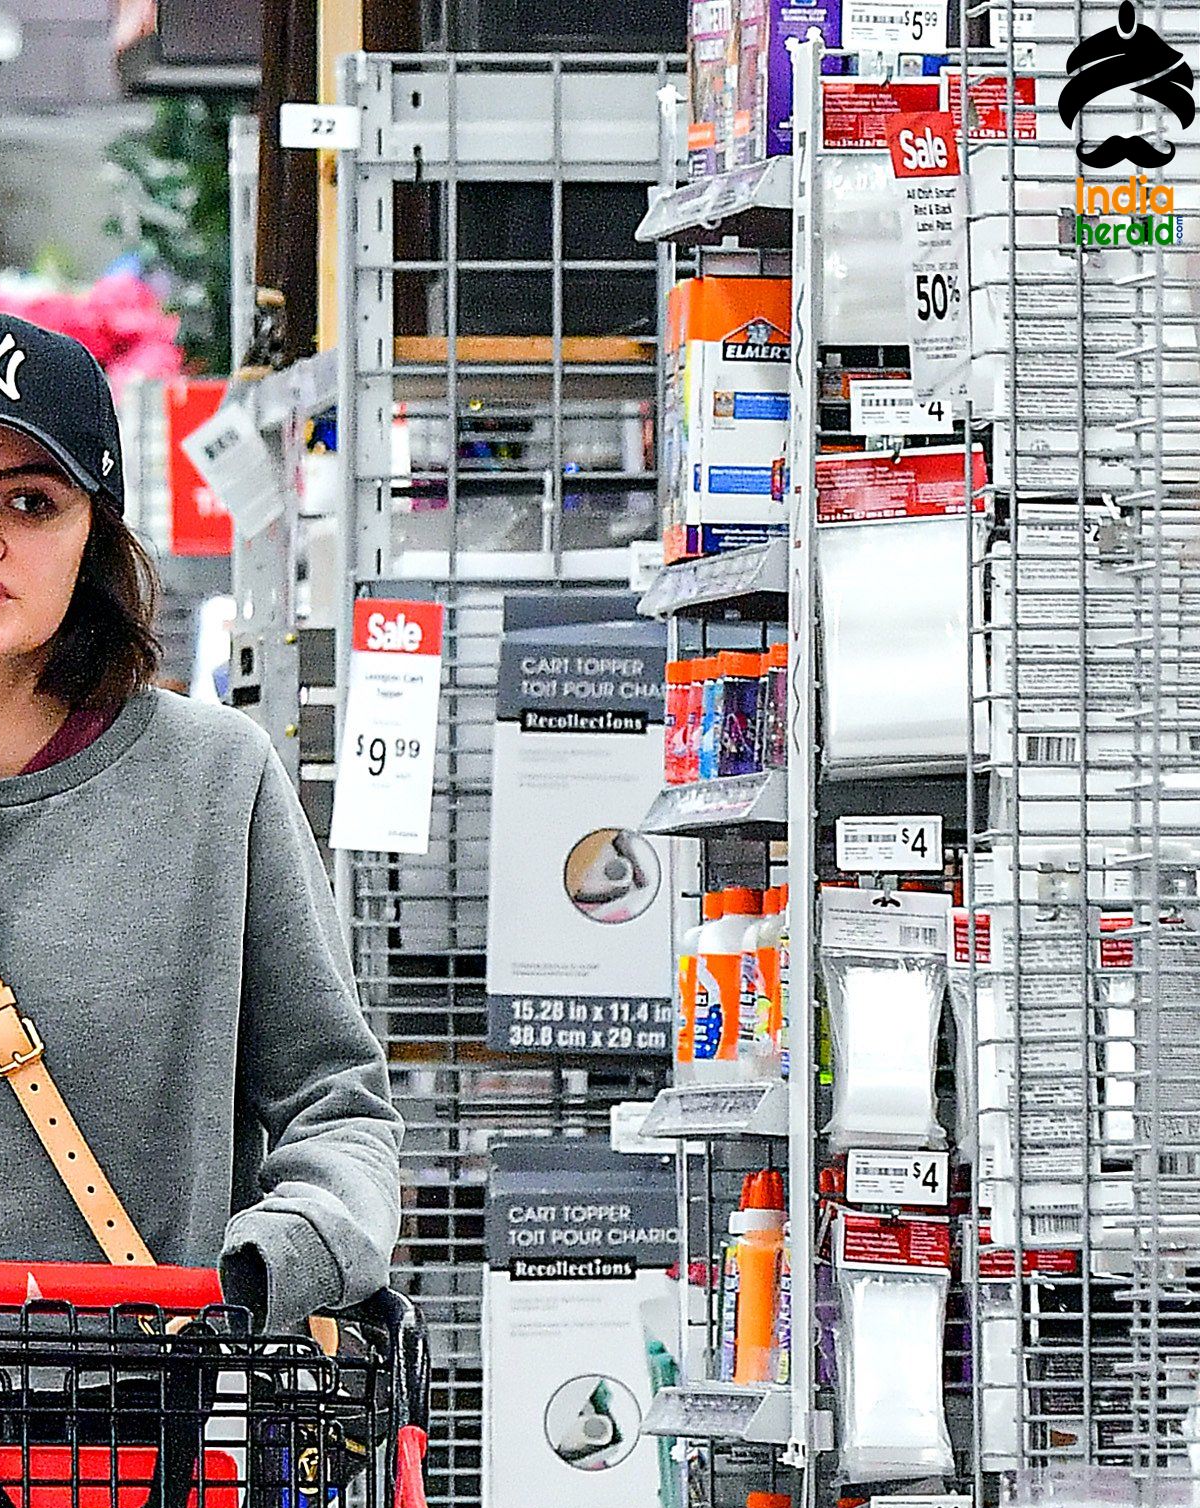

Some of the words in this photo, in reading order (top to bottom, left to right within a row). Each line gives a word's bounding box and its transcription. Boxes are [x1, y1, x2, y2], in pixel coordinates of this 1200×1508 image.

[311, 118, 337, 136] 22
[899, 126, 948, 170] Sale
[367, 612, 423, 651] Sale
[520, 656, 569, 675] CART
[577, 656, 645, 676] TOPPER
[521, 679, 558, 698] TOIT
[563, 680, 615, 699] POUR
[525, 711, 643, 731] Recollections
[901, 827, 928, 859] $4
[511, 999, 565, 1022] 15.28
[569, 1001, 588, 1022] in
[592, 1004, 604, 1022] x
[609, 1002, 649, 1022] 11.4
[655, 1002, 672, 1023] in
[509, 1024, 553, 1047] 38.8
[557, 1029, 587, 1047] cm
[591, 1030, 603, 1048] x
[608, 1026, 633, 1048] 29
[637, 1031, 666, 1049] cm
[912, 1161, 939, 1194] $4
[509, 1205, 557, 1224] CART
[562, 1205, 631, 1223] TOPPER
[508, 1230, 547, 1247] TOIT
[551, 1230, 602, 1247] POUR
[607, 1229, 680, 1245] CHARIO
[514, 1259, 632, 1278] Recollections
